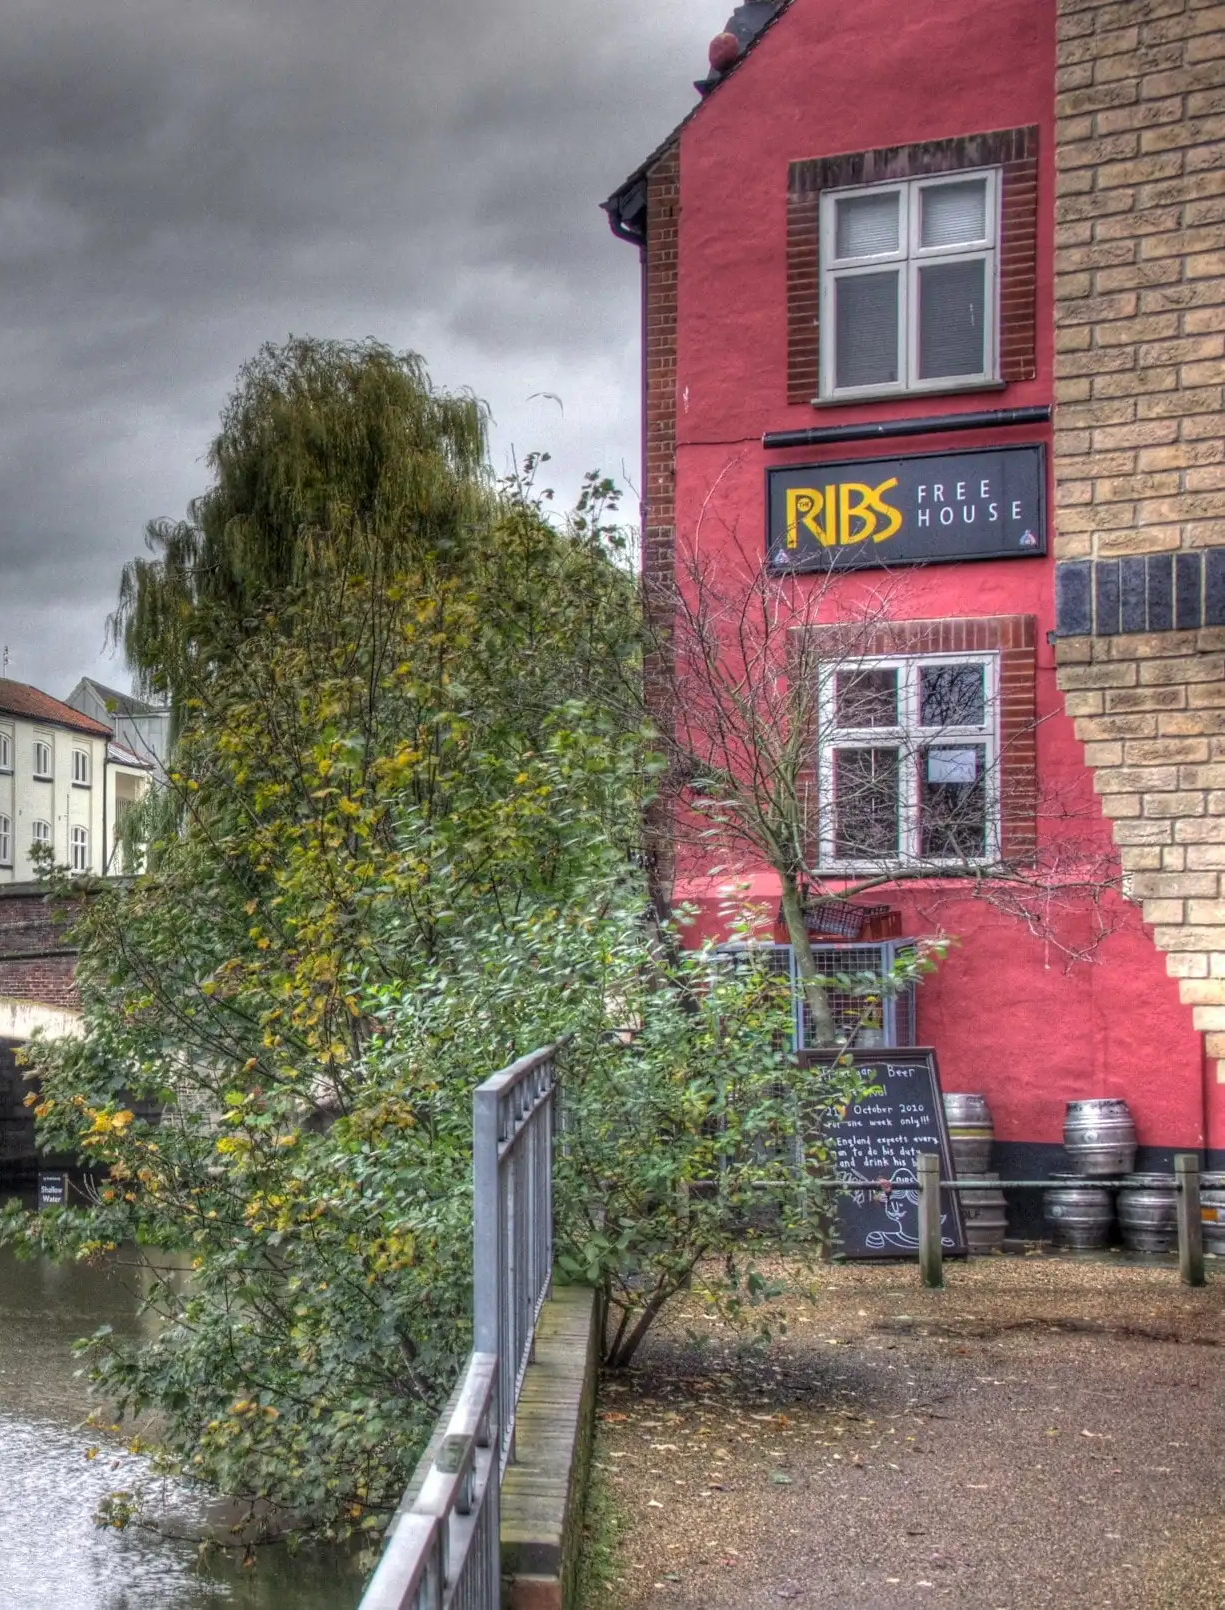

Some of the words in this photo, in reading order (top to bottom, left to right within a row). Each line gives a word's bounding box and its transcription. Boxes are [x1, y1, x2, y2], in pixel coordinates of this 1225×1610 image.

[917, 480, 990, 503] FREE
[786, 477, 902, 549] RIBS
[917, 501, 1022, 527] HOUSE
[887, 1064, 915, 1078] Beer
[853, 1104, 893, 1115] October
[847, 1119, 863, 1127] one
[870, 1118, 893, 1126] week
[900, 1116, 930, 1128] only!!!
[836, 1135, 871, 1147] England
[877, 1135, 908, 1146] expects
[913, 1136, 939, 1144] every
[852, 1147, 863, 1157] to
[868, 1146, 878, 1156] do
[882, 1145, 894, 1156] his
[839, 1157, 855, 1167] and
[864, 1157, 890, 1167] drink
[892, 1156, 906, 1167] his
